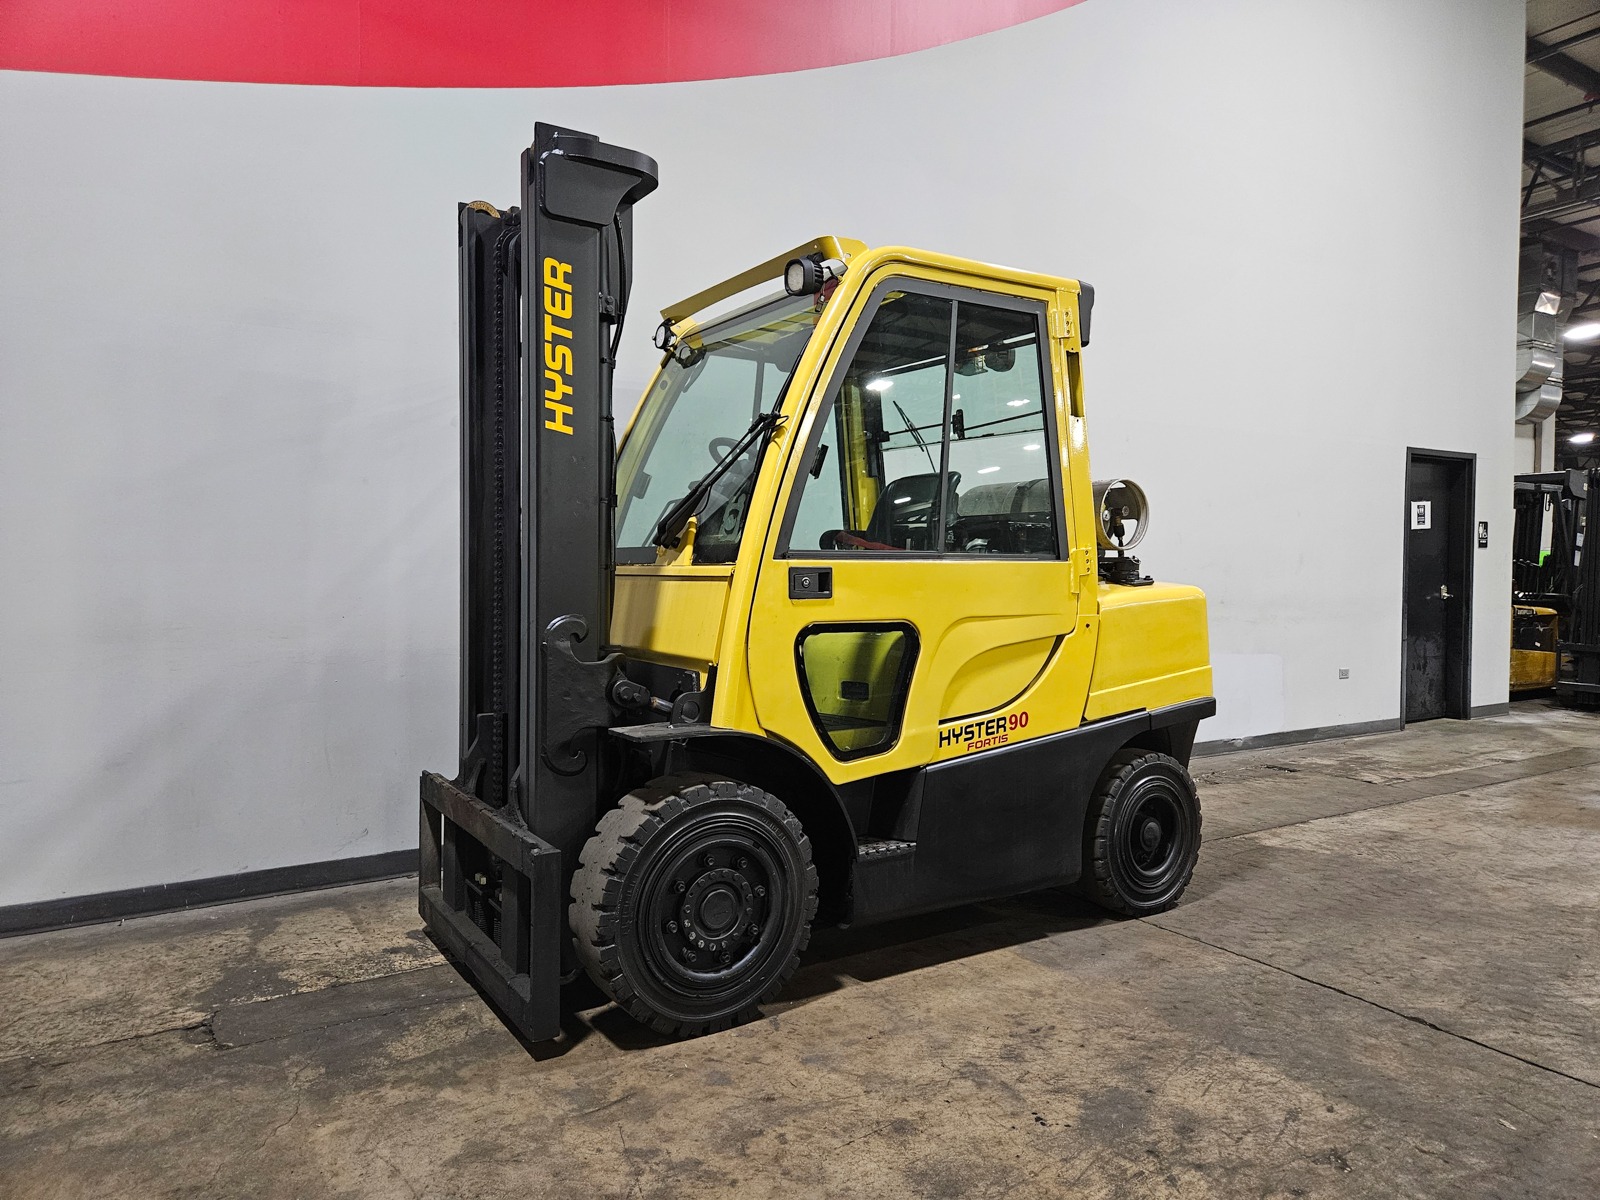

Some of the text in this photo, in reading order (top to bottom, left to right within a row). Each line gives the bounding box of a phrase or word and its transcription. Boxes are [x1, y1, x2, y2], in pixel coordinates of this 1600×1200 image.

[544, 257, 573, 435] HYSTER
[939, 711, 1029, 748] HYSTER 90
[967, 734, 1008, 751] FORTIS
